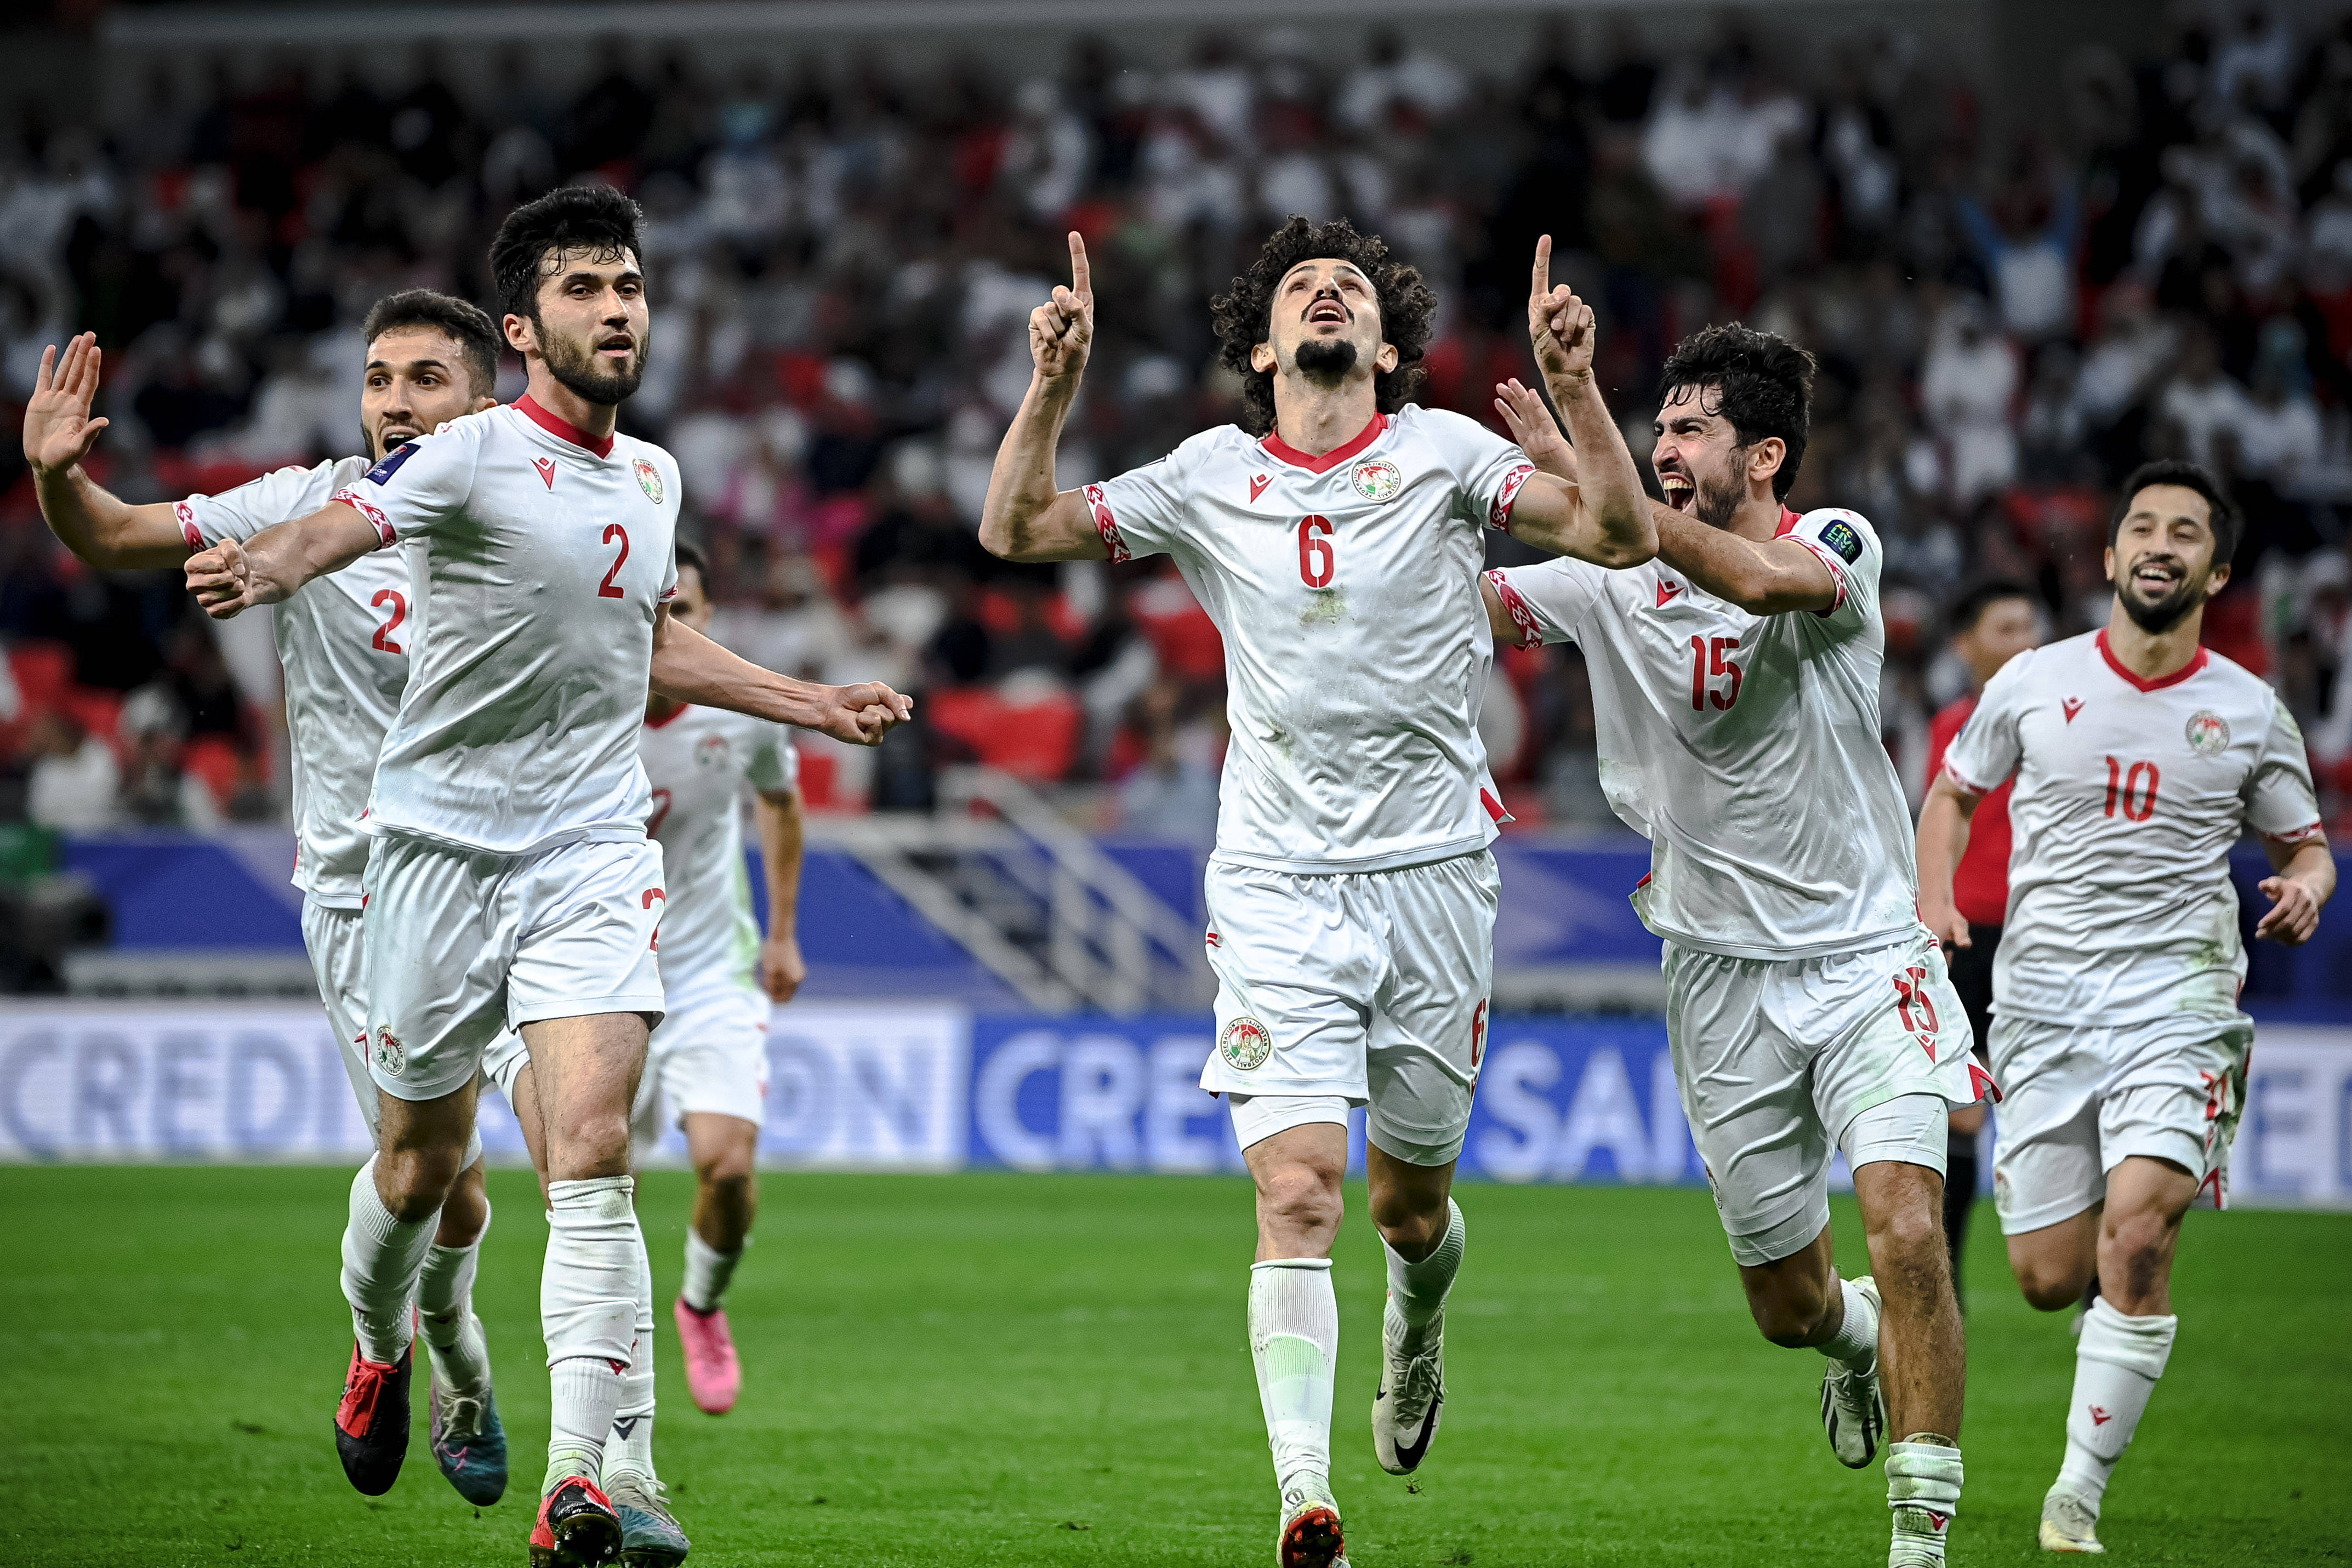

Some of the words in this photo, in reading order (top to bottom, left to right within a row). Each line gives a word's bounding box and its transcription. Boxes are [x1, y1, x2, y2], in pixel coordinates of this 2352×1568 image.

[598, 523, 629, 599] 2
[1298, 514, 1334, 588] 6
[1835, 524, 1853, 538] AFC
[370, 589, 412, 655] 2
[1692, 635, 1742, 711] 15
[2105, 755, 2160, 822] 10
[1245, 1019, 1268, 1047] TAJIKISTAN
[1893, 966, 1939, 1034] 15
[1222, 1022, 1236, 1061] FEDERATION
[1236, 1051, 1266, 1068] FOOTBALL
[0, 1026, 354, 1159] CREDI
